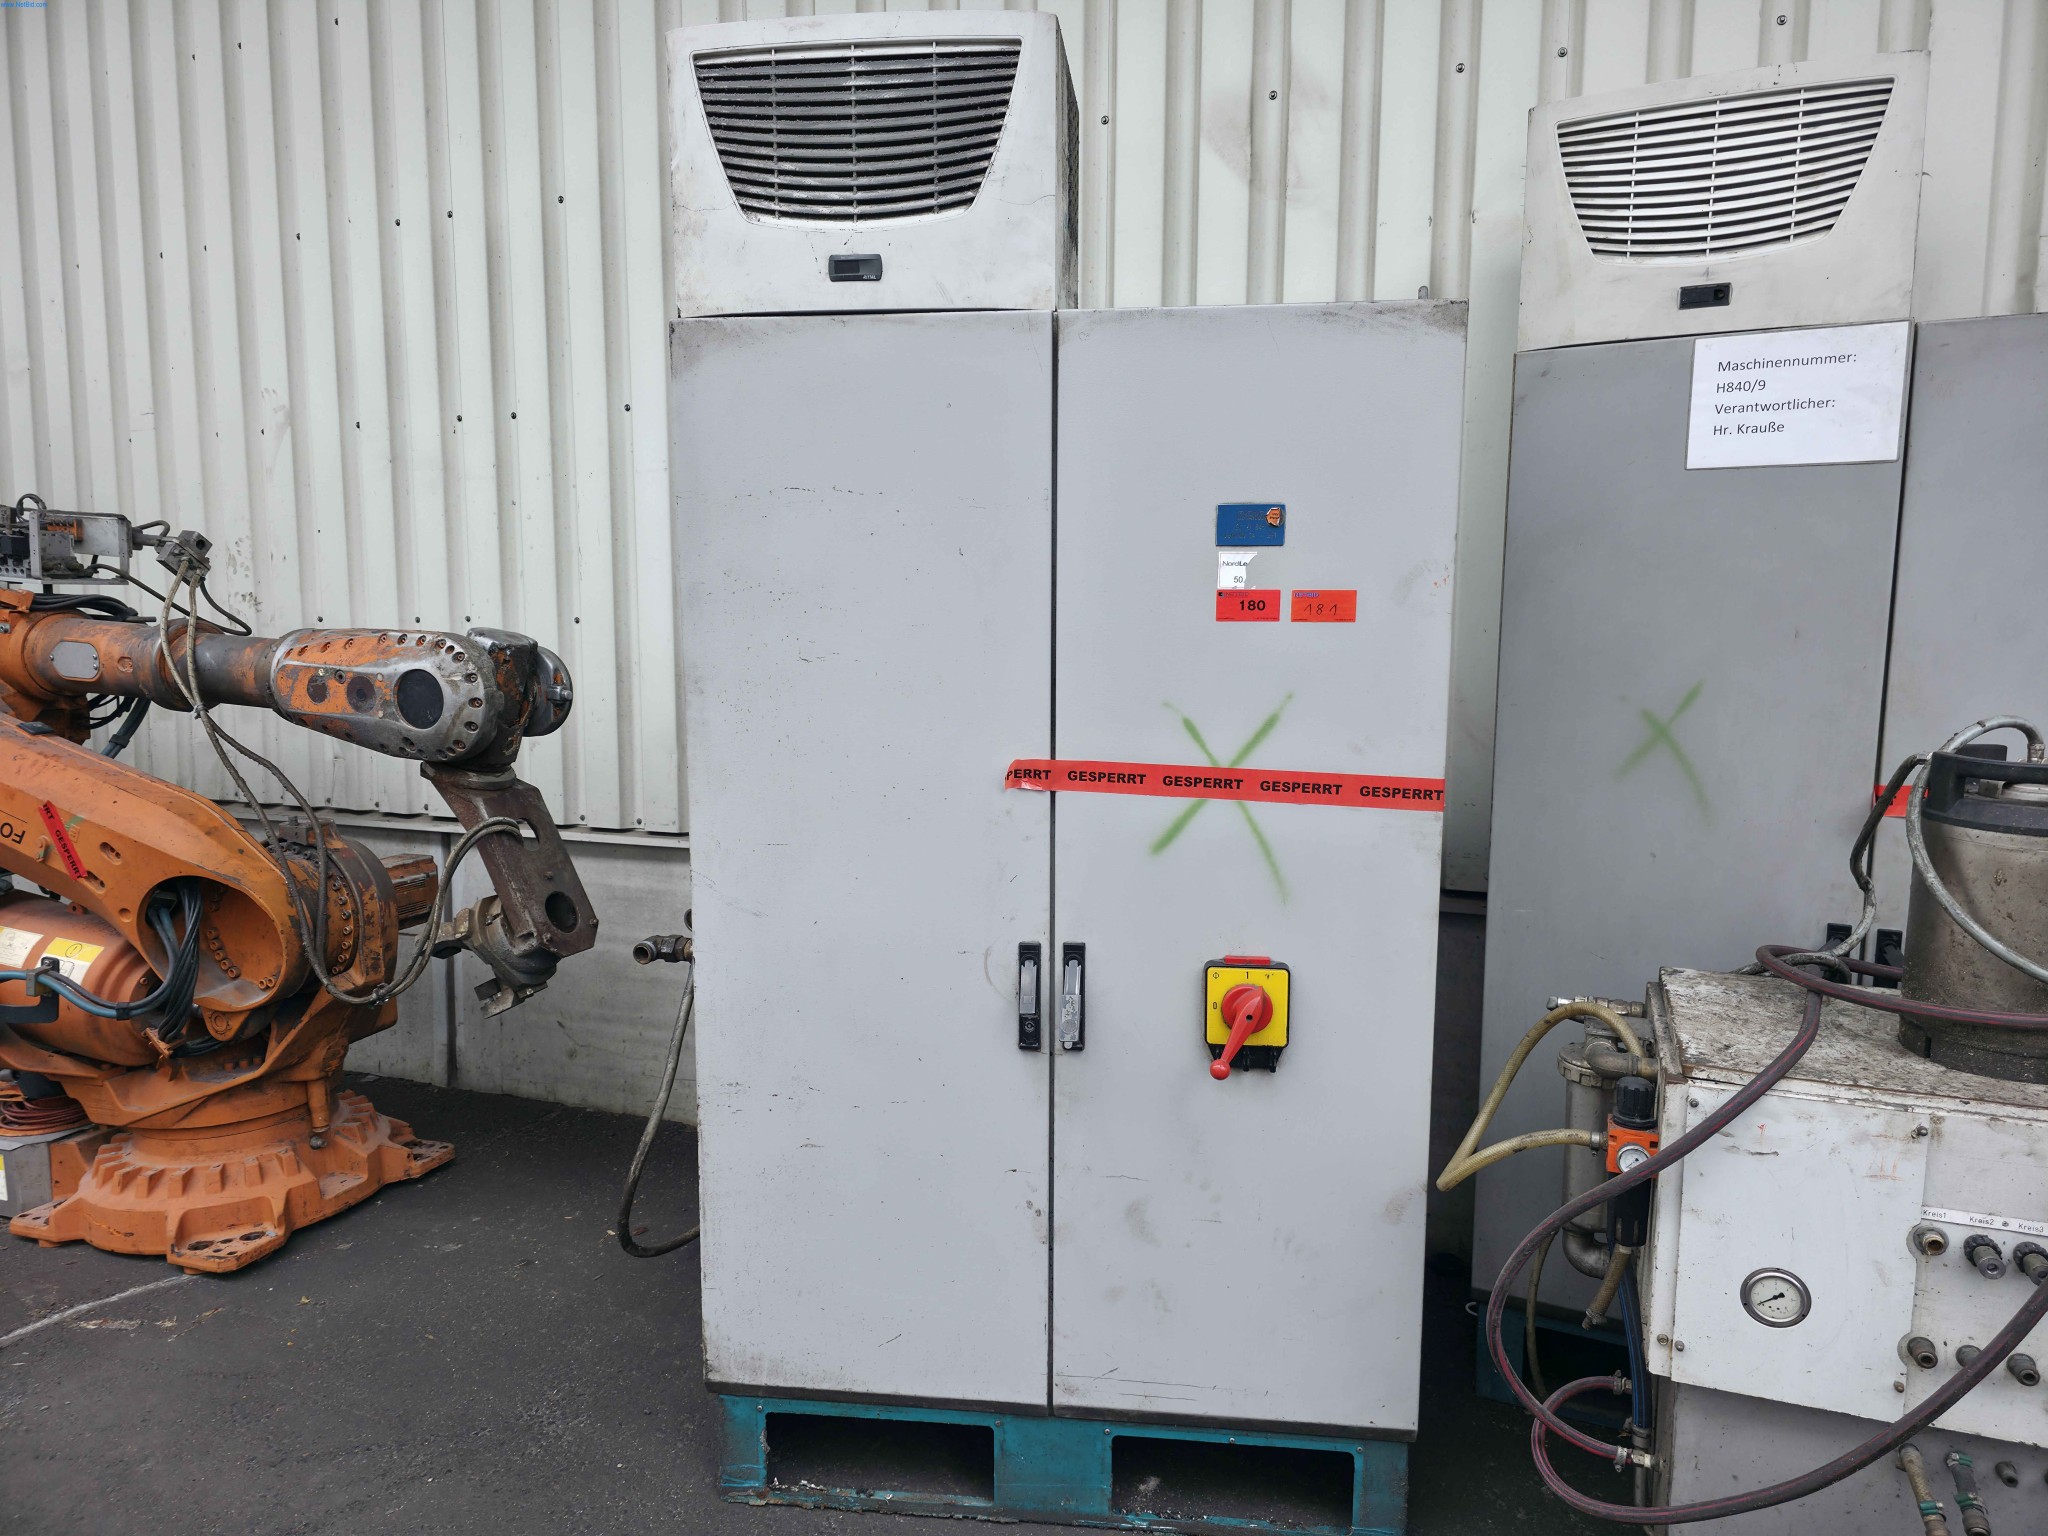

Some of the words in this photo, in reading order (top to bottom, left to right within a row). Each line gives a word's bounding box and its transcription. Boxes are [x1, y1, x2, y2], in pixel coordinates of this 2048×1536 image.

[1717, 352, 1857, 372] Maschinennummer:
[1716, 379, 1766, 394] H840/9
[1714, 397, 1836, 415] Verantwortlicher:
[1713, 424, 1732, 436] Hr.
[1736, 421, 1785, 435] Krauße
[1239, 599, 1266, 611] 180
[1067, 771, 1147, 786] GESPERRT
[1162, 775, 1244, 790] GESPERRT
[1259, 780, 1343, 795] GESPERRT
[1359, 785, 1444, 801] GESPERRT
[1922, 1209, 1947, 1219] Kreis1
[1969, 1216, 1995, 1226] Kreis2
[2018, 1222, 2044, 1233] Kreis3
